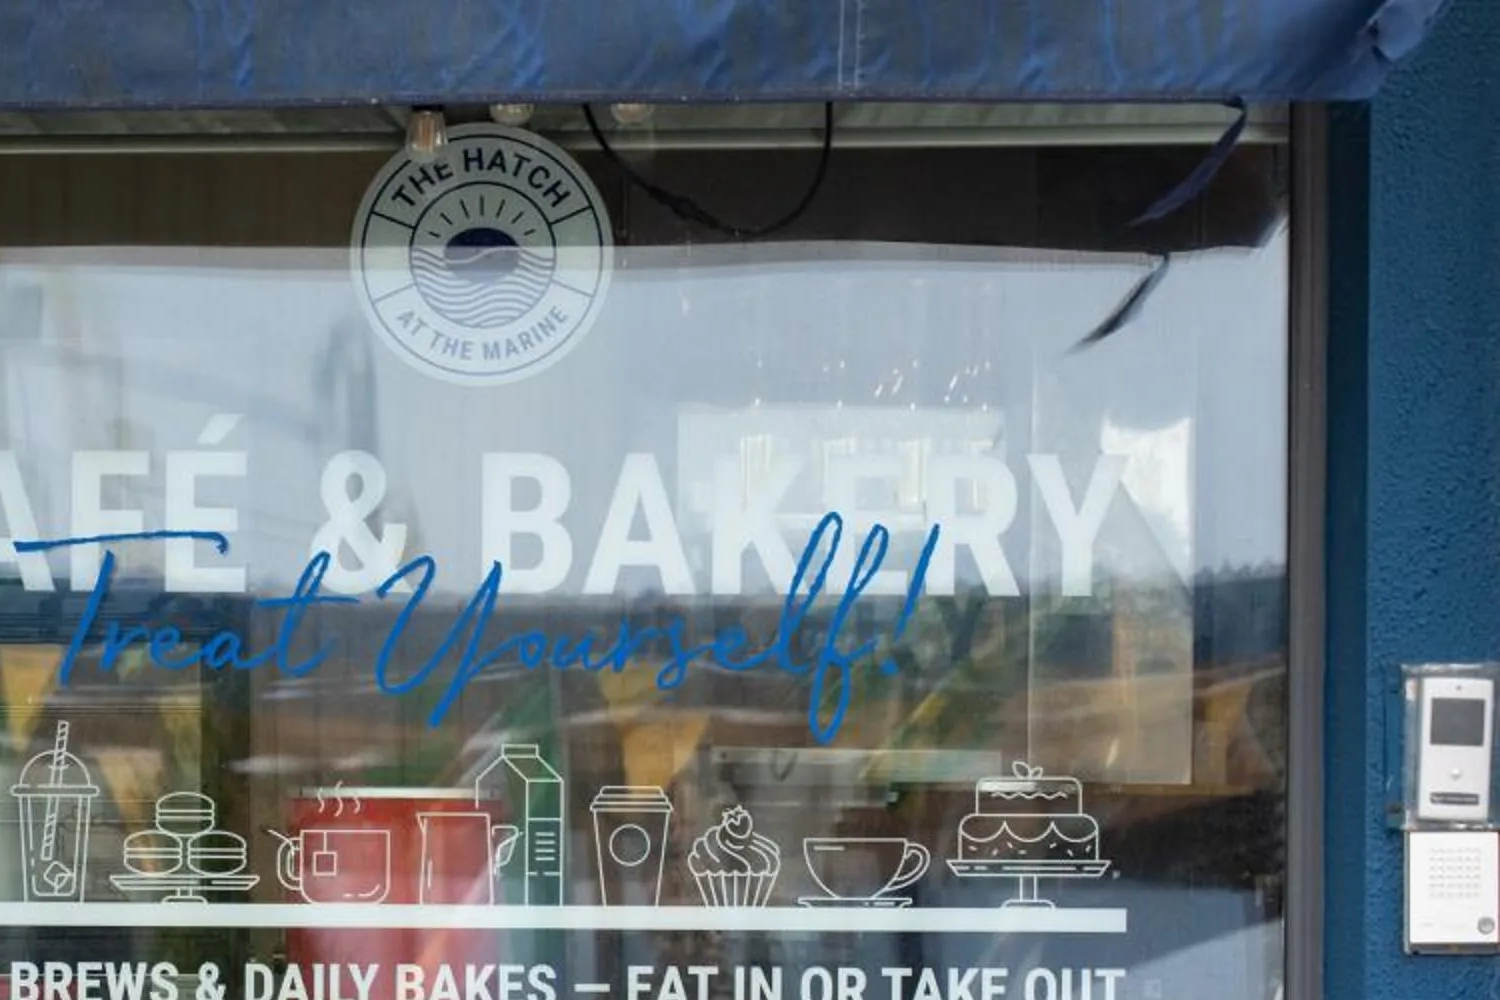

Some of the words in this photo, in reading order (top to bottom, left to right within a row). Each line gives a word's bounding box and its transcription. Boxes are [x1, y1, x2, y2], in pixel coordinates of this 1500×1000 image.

[390, 161, 454, 208] THE
[462, 147, 571, 208] HATCH
[396, 309, 424, 337] AT
[427, 328, 474, 361] THE
[482, 304, 568, 361] MARINE
[309, 449, 412, 593] &
[480, 451, 1129, 598] BAKERY
[12, 529, 360, 689] Treat
[375, 510, 940, 745] Yourself!
